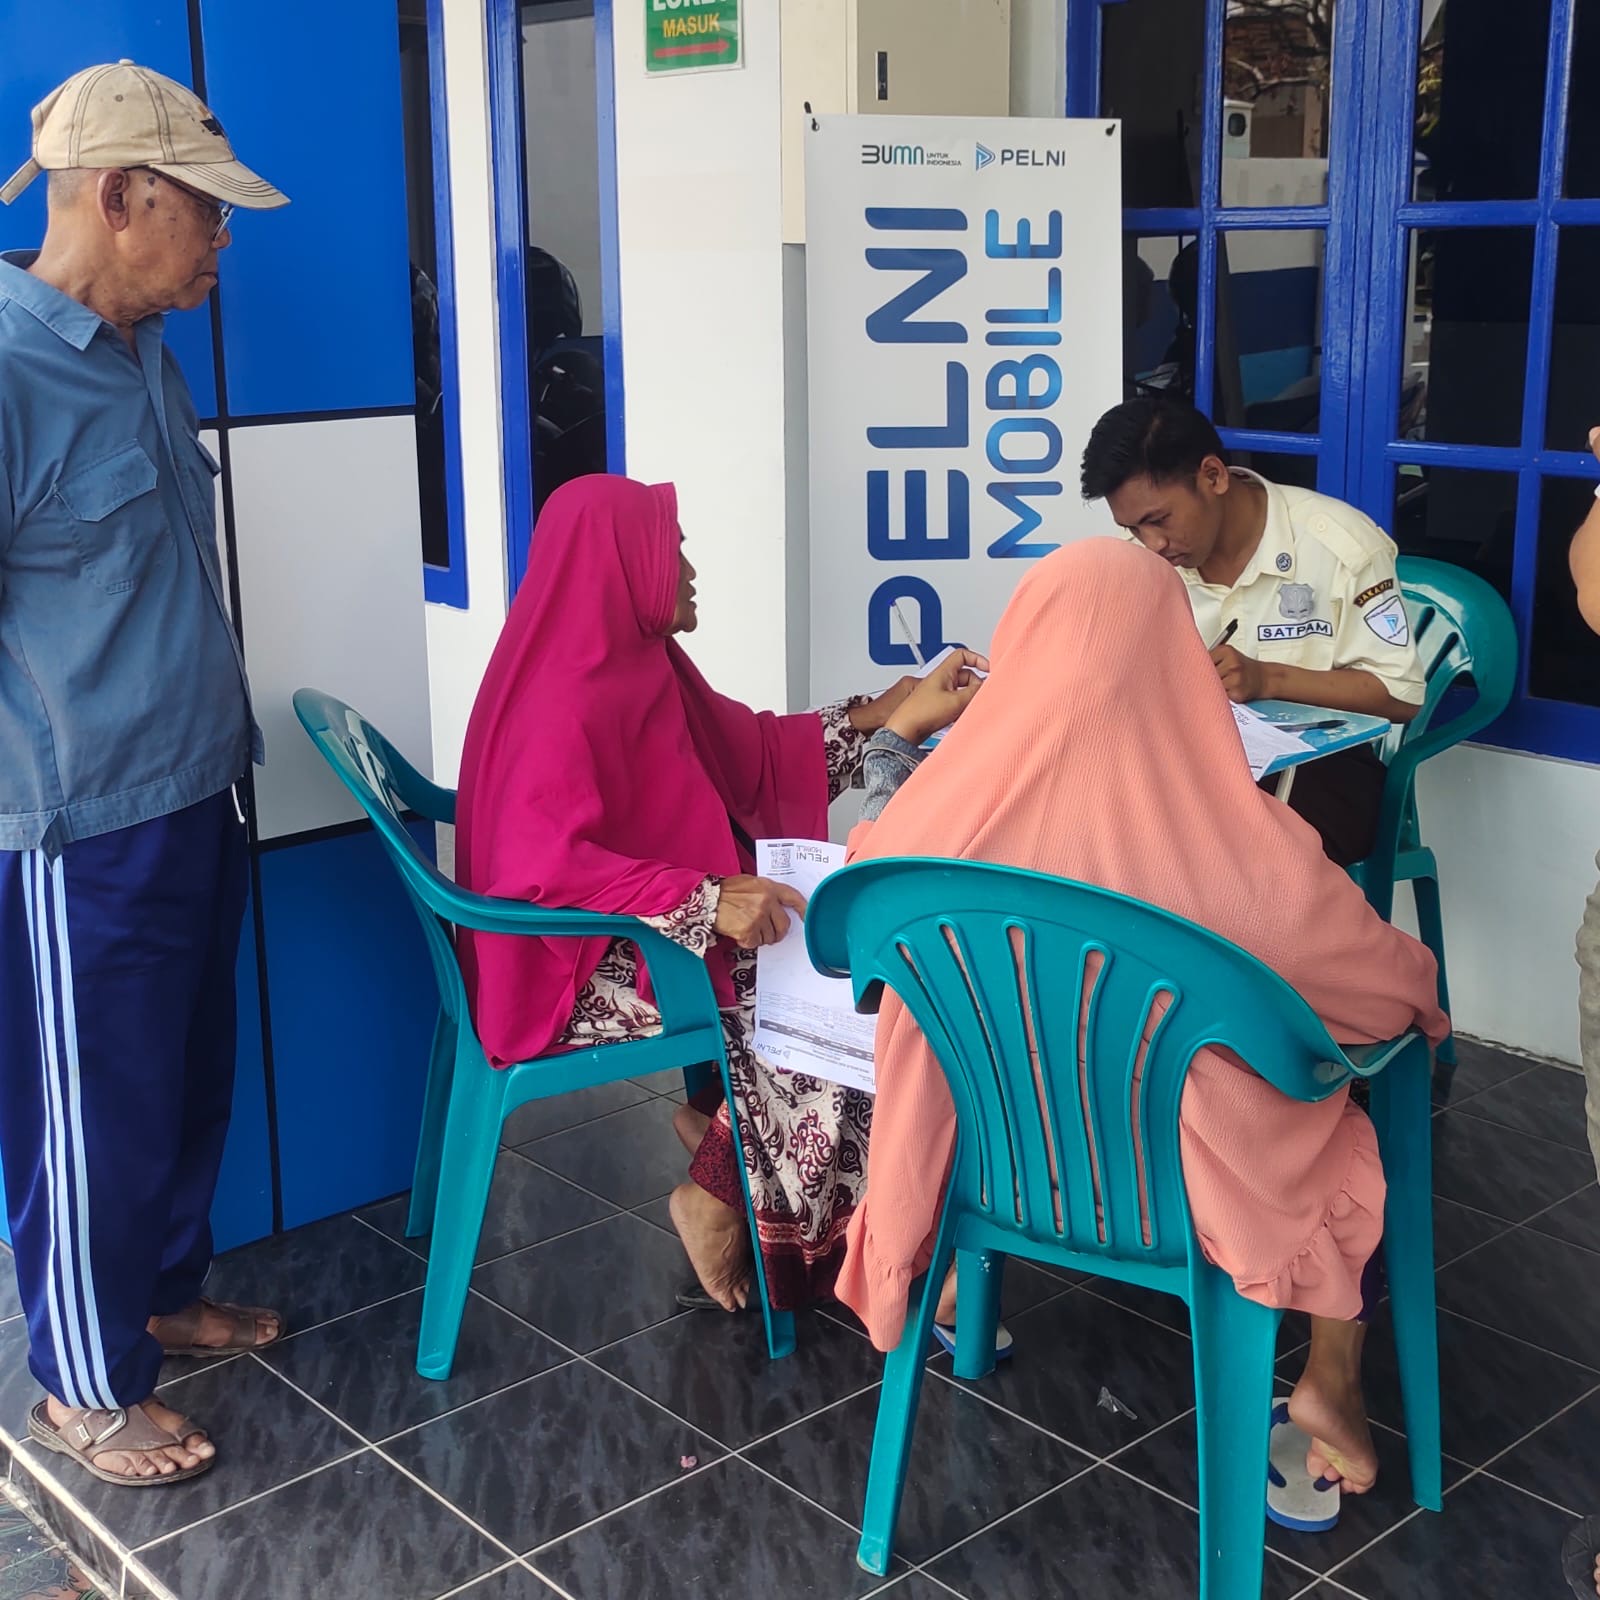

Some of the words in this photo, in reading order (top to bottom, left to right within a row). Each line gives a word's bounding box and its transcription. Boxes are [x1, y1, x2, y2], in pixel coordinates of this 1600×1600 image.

[663, 12, 720, 38] MASUK
[1000, 149, 1066, 167] PELNI
[985, 208, 1063, 559] MOBILE
[864, 207, 971, 666] PELNI
[1263, 622, 1329, 638] SATPAM
[796, 852, 830, 863] PELNI
[756, 1042, 783, 1056] PELNI
